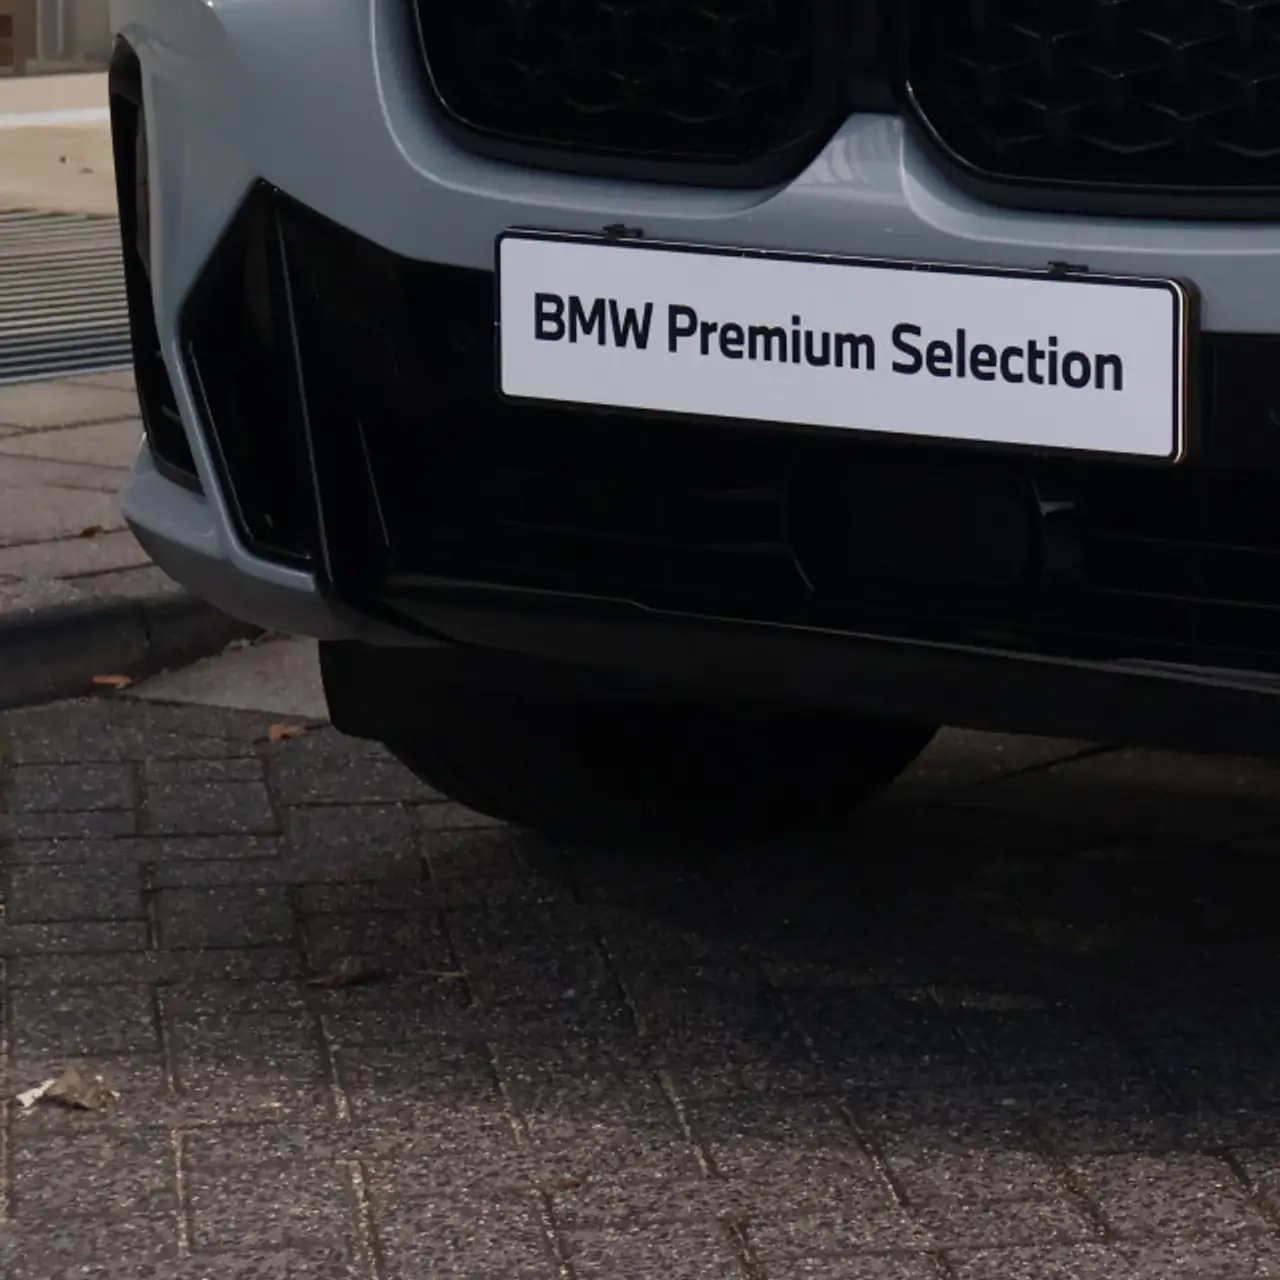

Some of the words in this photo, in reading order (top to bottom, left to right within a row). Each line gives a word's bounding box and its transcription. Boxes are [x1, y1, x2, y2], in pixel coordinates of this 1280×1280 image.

[533, 291, 653, 351] BMW
[667, 303, 876, 372] Premium
[890, 322, 1124, 392] Selection
